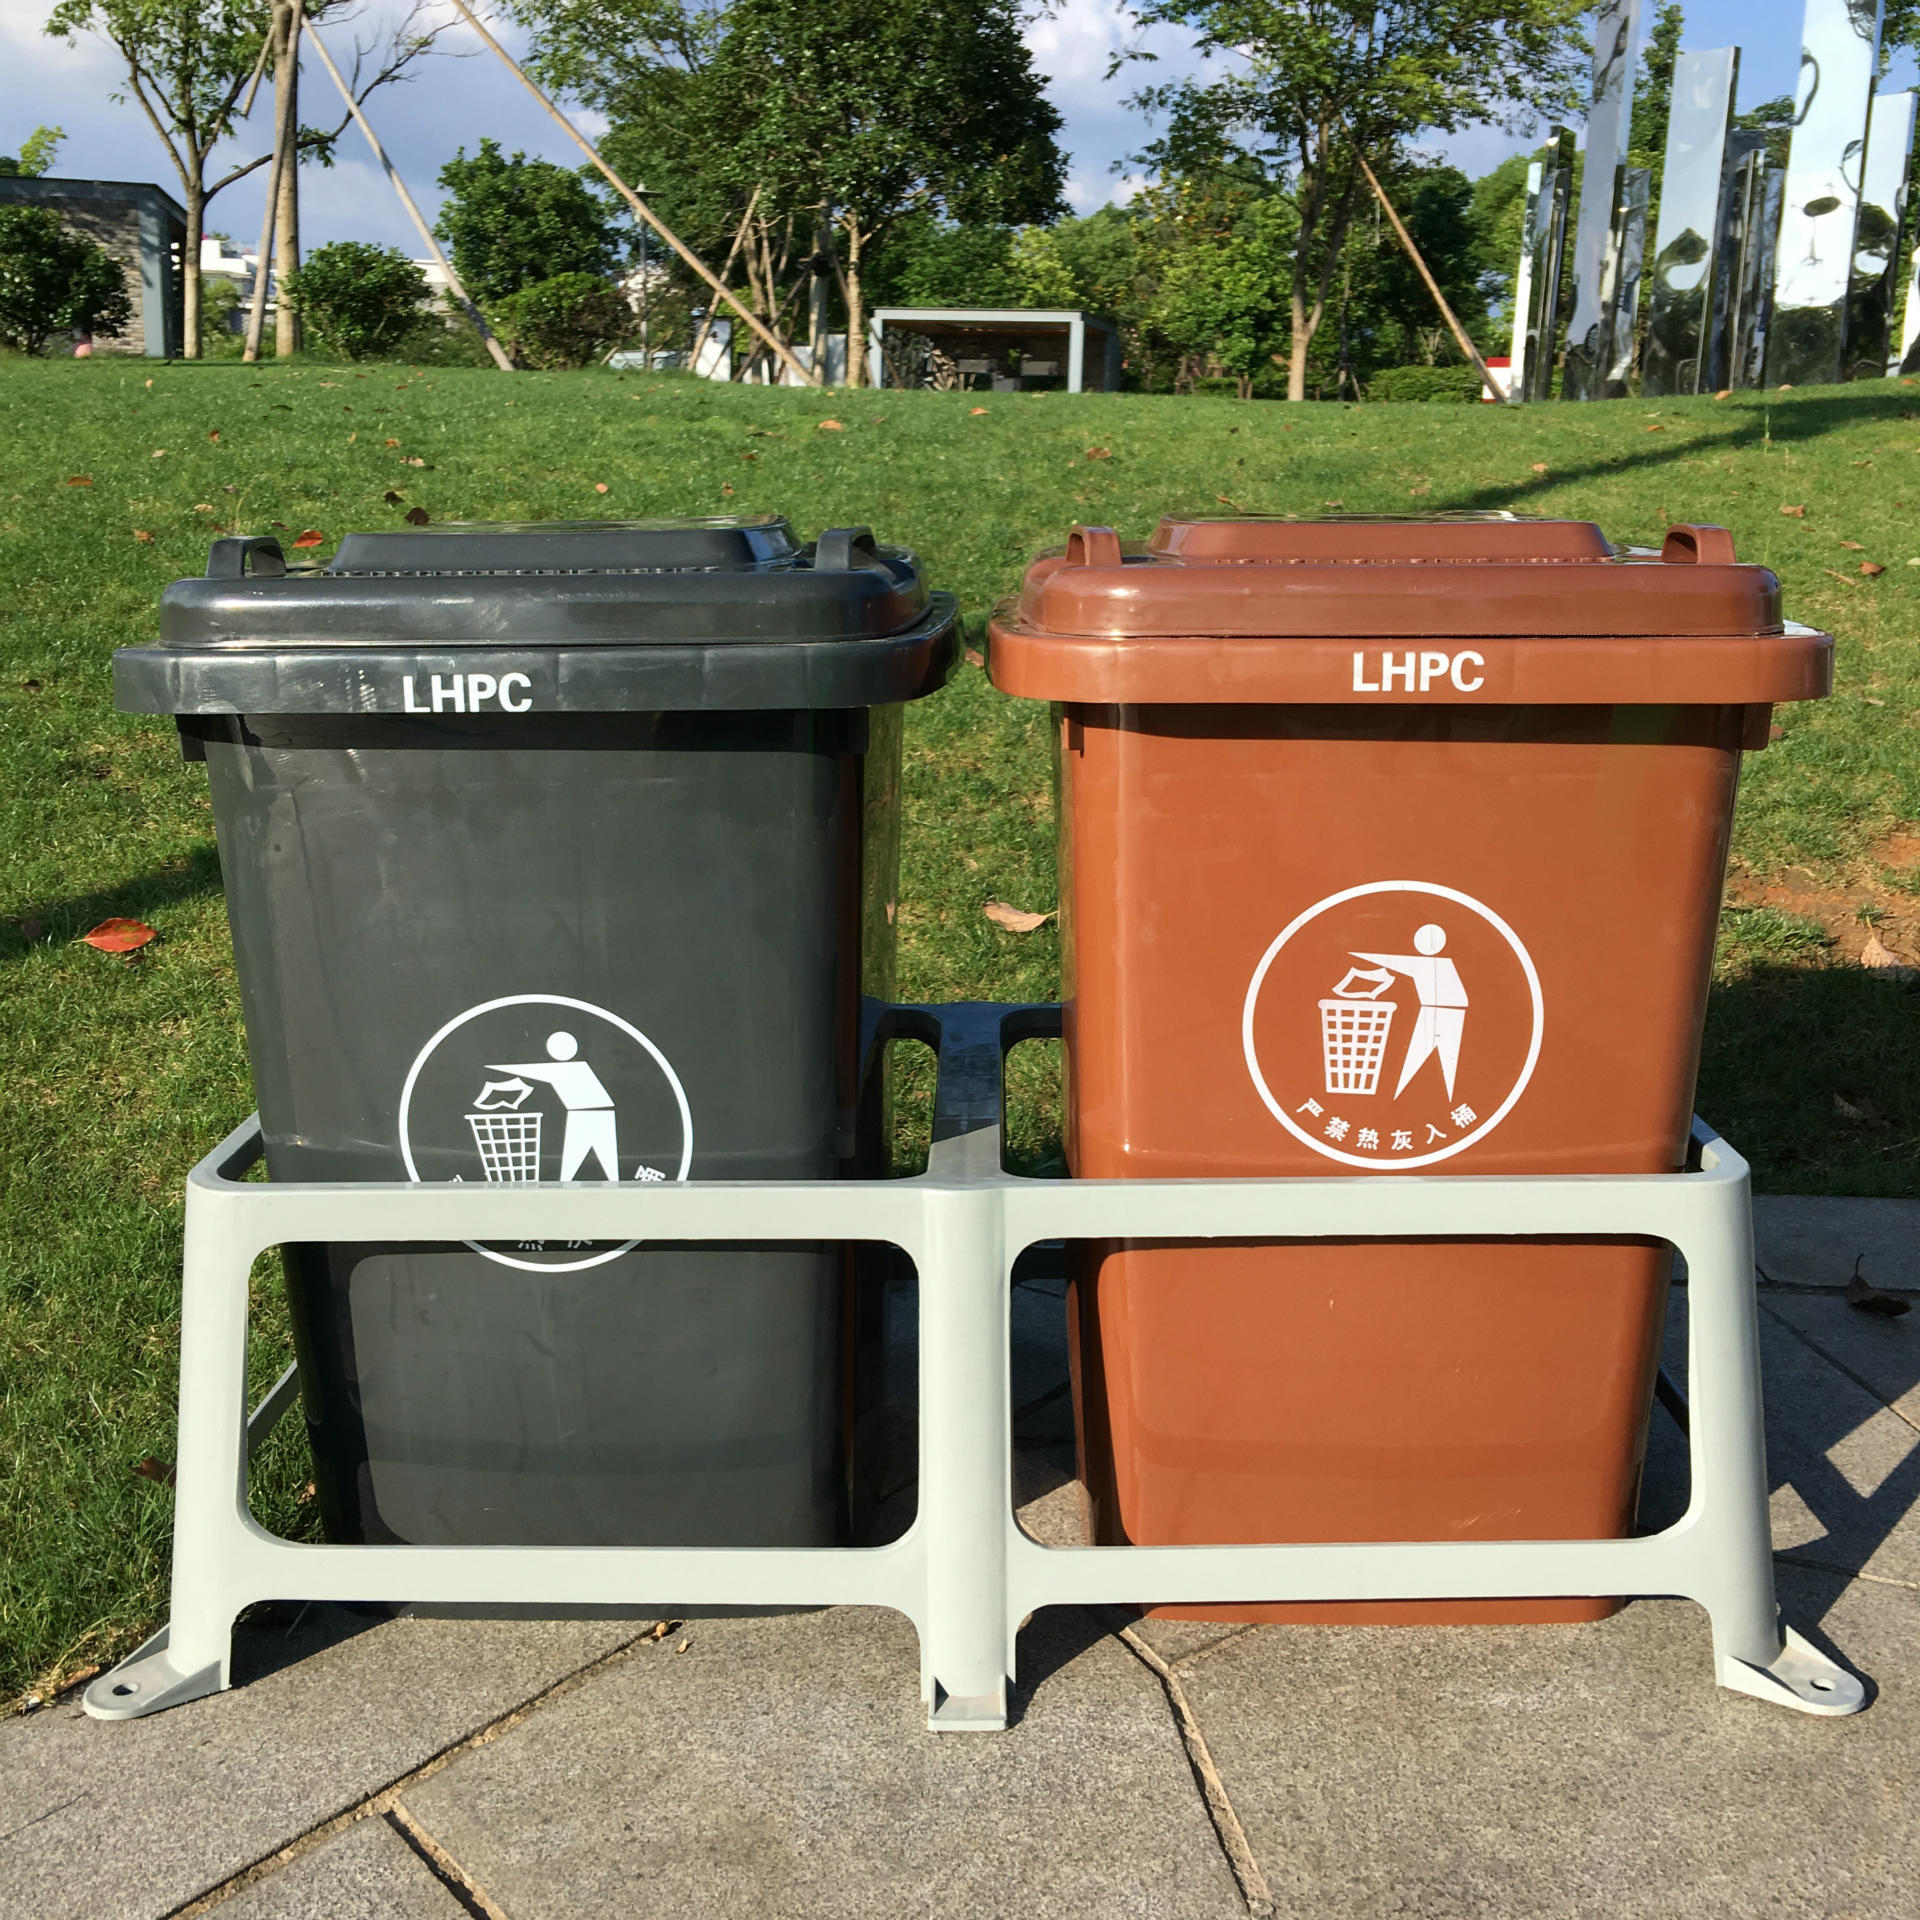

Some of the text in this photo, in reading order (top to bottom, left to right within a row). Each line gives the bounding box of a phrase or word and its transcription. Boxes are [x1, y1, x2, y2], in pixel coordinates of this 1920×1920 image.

[1352, 651, 1485, 692] LHPC
[402, 672, 533, 713] LHPC
[1296, 1097, 1478, 1151] 严禁热灰入桶
